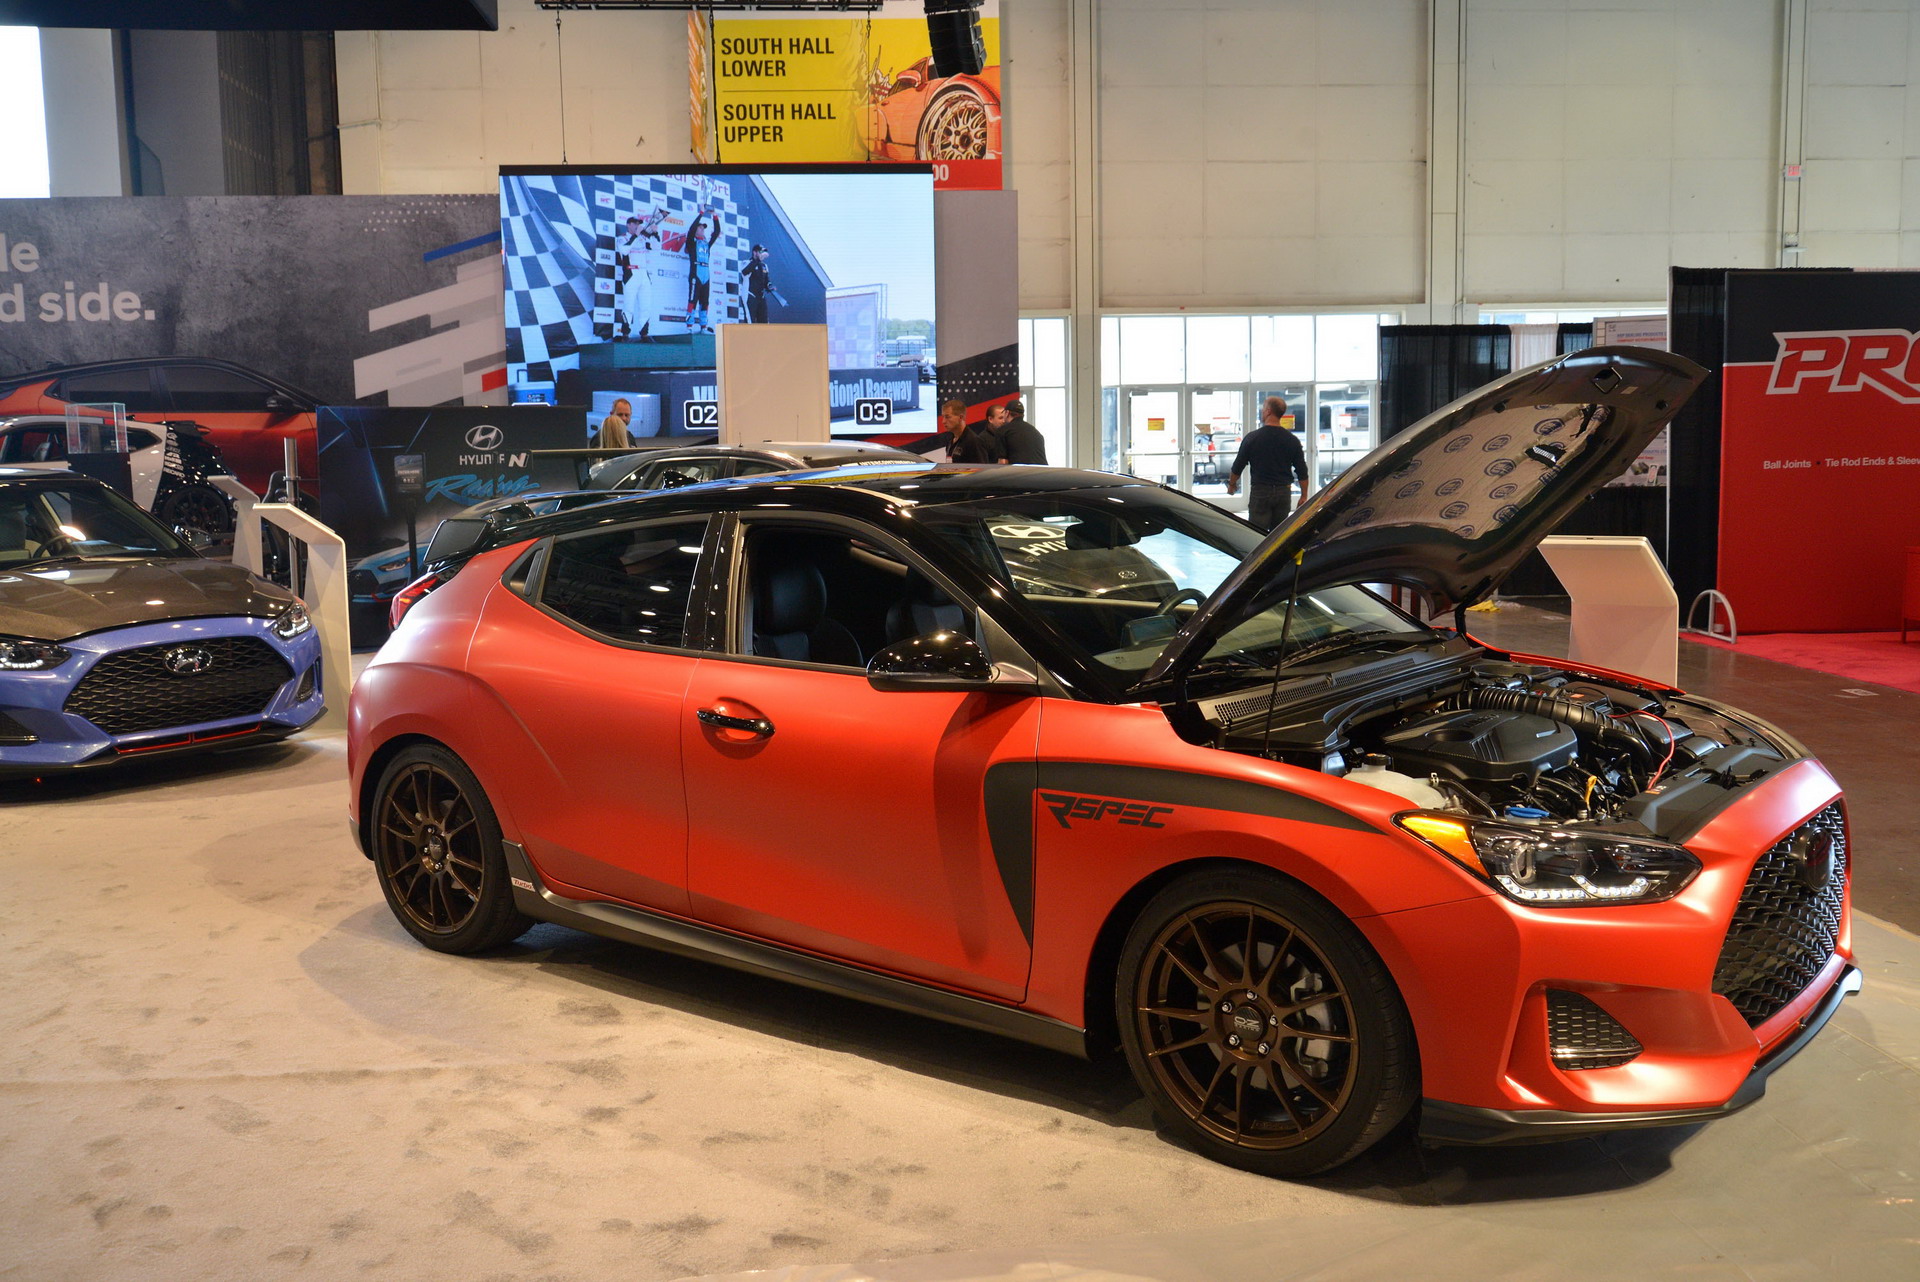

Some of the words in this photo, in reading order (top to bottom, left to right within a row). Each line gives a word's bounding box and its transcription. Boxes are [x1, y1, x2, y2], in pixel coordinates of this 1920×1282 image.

[721, 38, 782, 55] SOUTH
[789, 38, 834, 54] HALL
[722, 60, 786, 77] LOWER
[723, 104, 784, 120] SOUTH
[791, 103, 836, 120] HALL
[724, 126, 783, 143] UPPER
[0, 283, 25, 323] d
[39, 281, 156, 323] side.
[1766, 328, 1920, 405] PR
[829, 379, 864, 408] tional
[866, 378, 912, 403] Raceway
[690, 406, 717, 424] 02
[860, 403, 887, 421] 03
[1763, 461, 1781, 469] Ball
[1783, 460, 1812, 469] Joints
[1825, 458, 1840, 467] Tie
[1841, 458, 1861, 467] Rod
[1862, 457, 1886, 466] Ends
[1888, 456, 1895, 465] &
[1040, 792, 1175, 830] RSPEC
